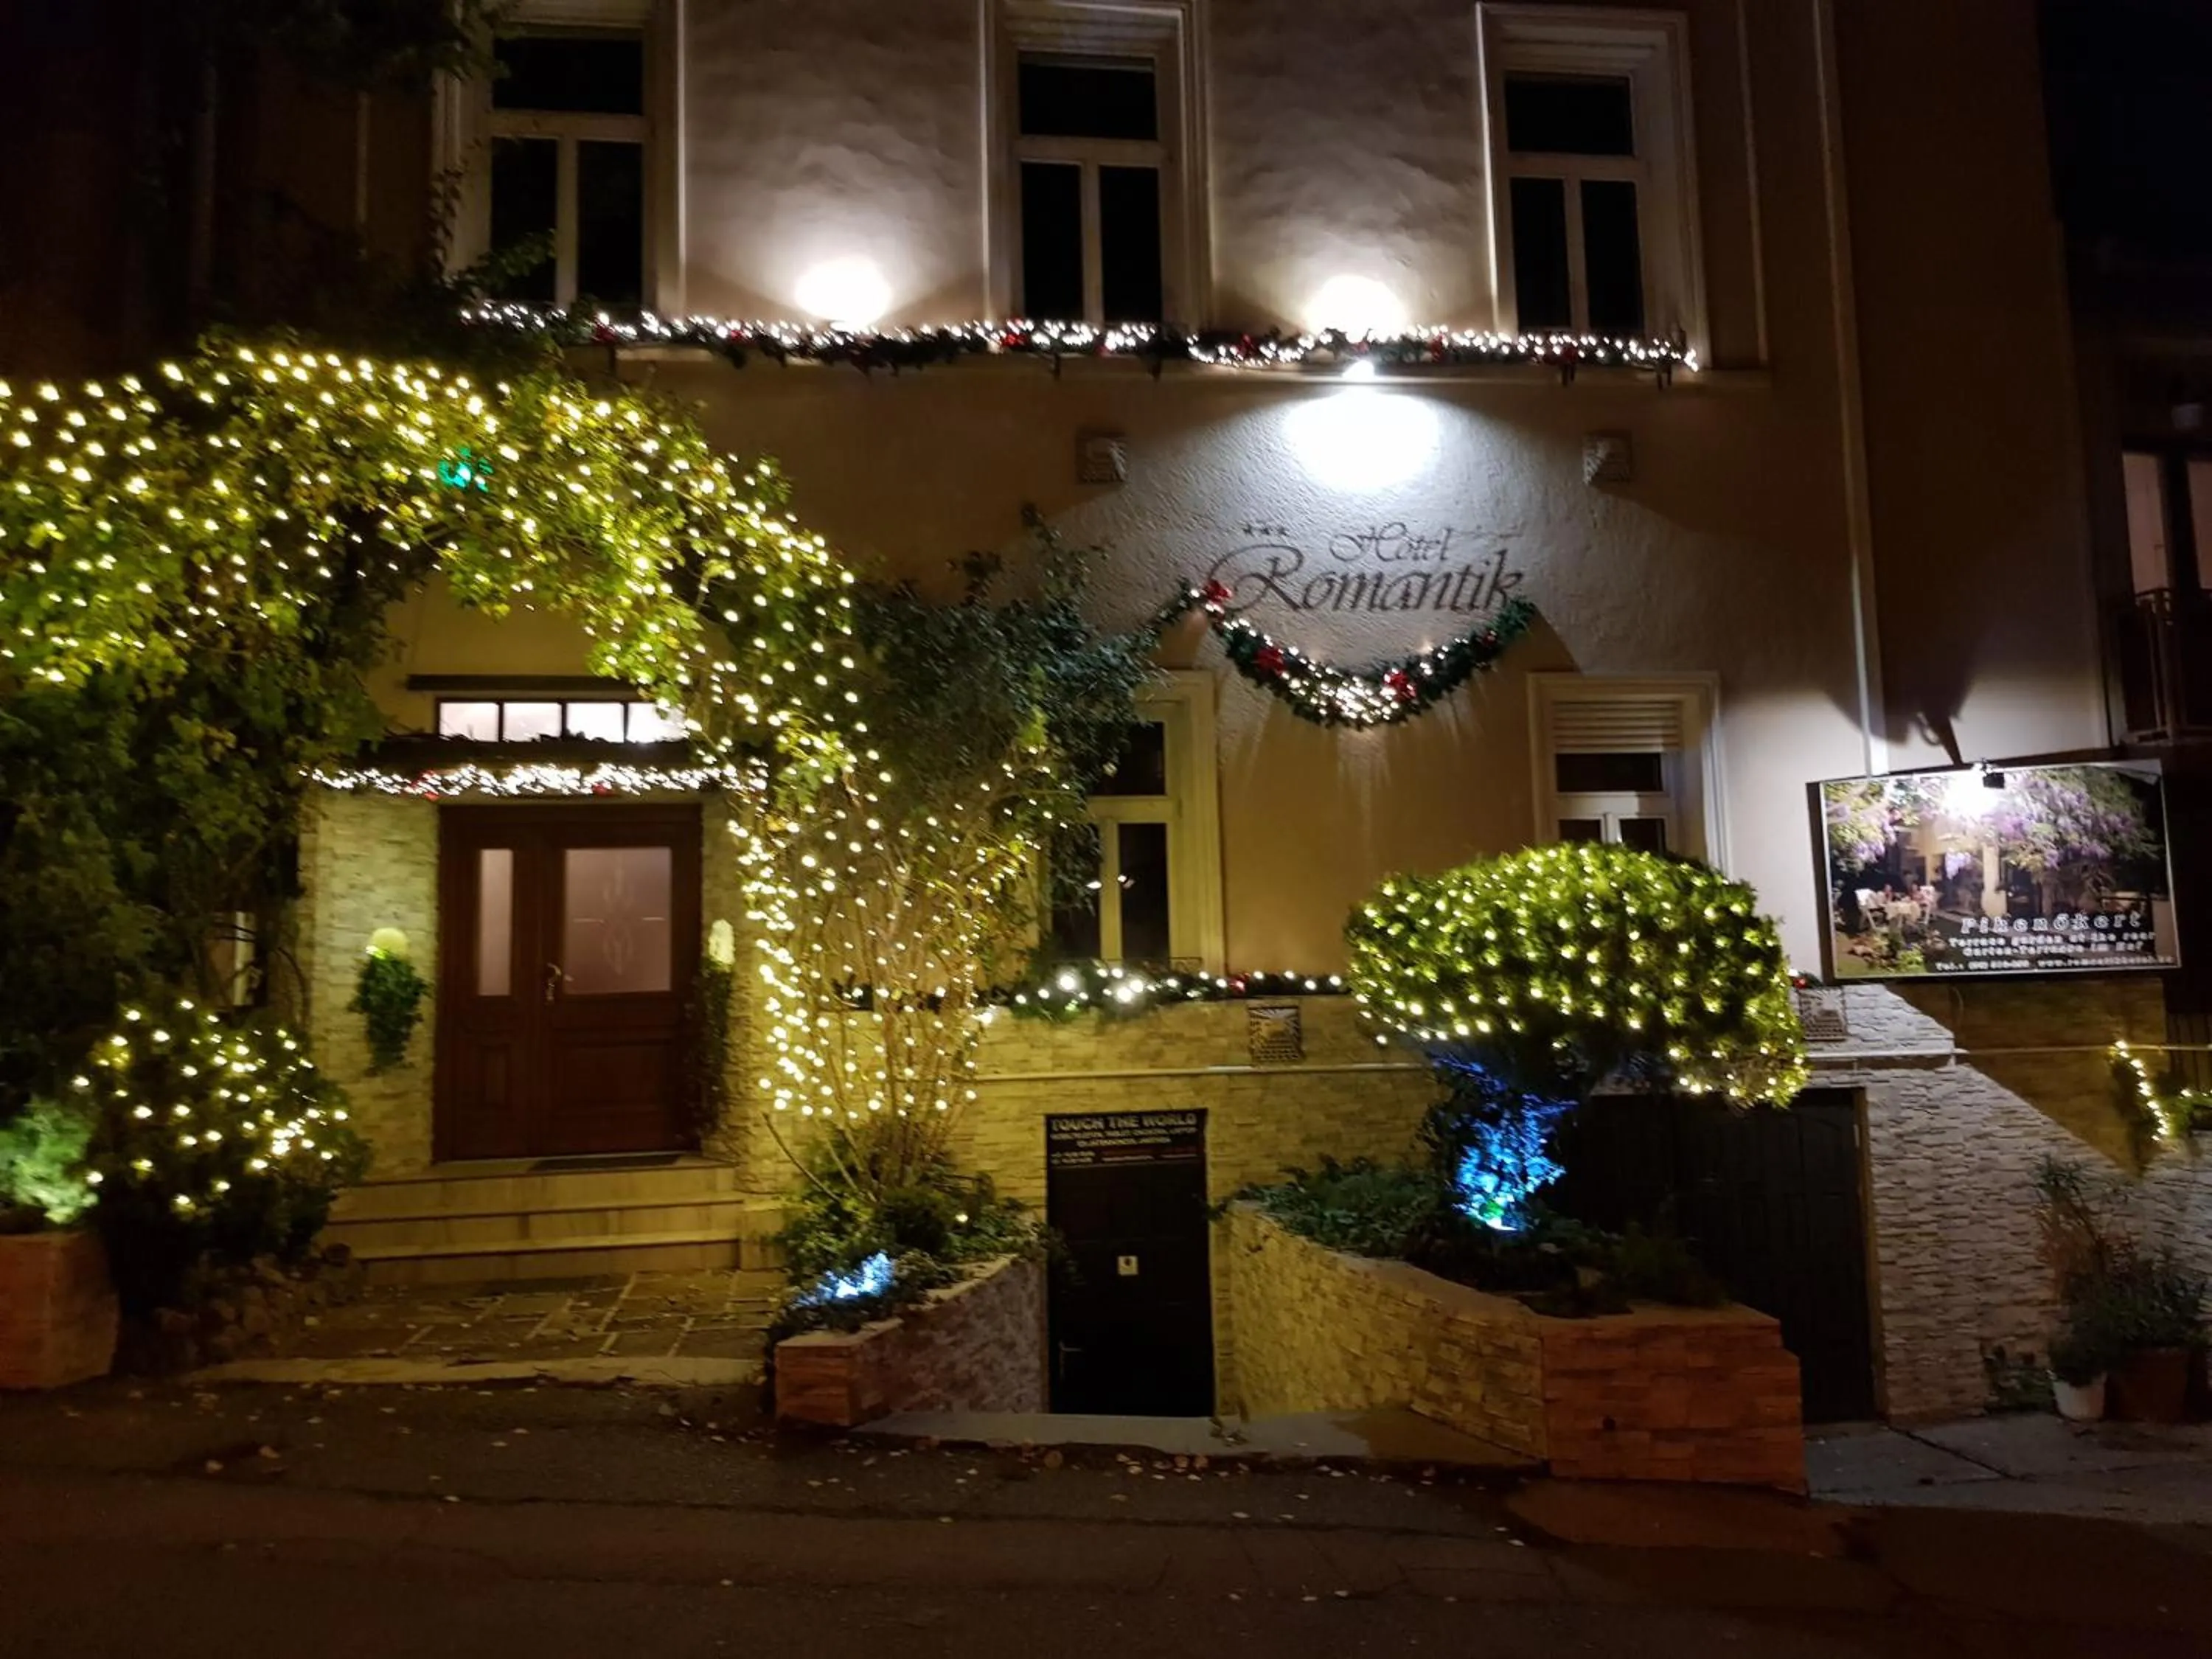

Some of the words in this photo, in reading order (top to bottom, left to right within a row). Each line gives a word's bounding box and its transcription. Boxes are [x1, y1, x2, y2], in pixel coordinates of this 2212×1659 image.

[1329, 521, 1460, 562] Hotel
[1207, 544, 1523, 612] Romantik
[1107, 1115, 1139, 1129] THE
[1143, 1113, 1197, 1127] WORLD
